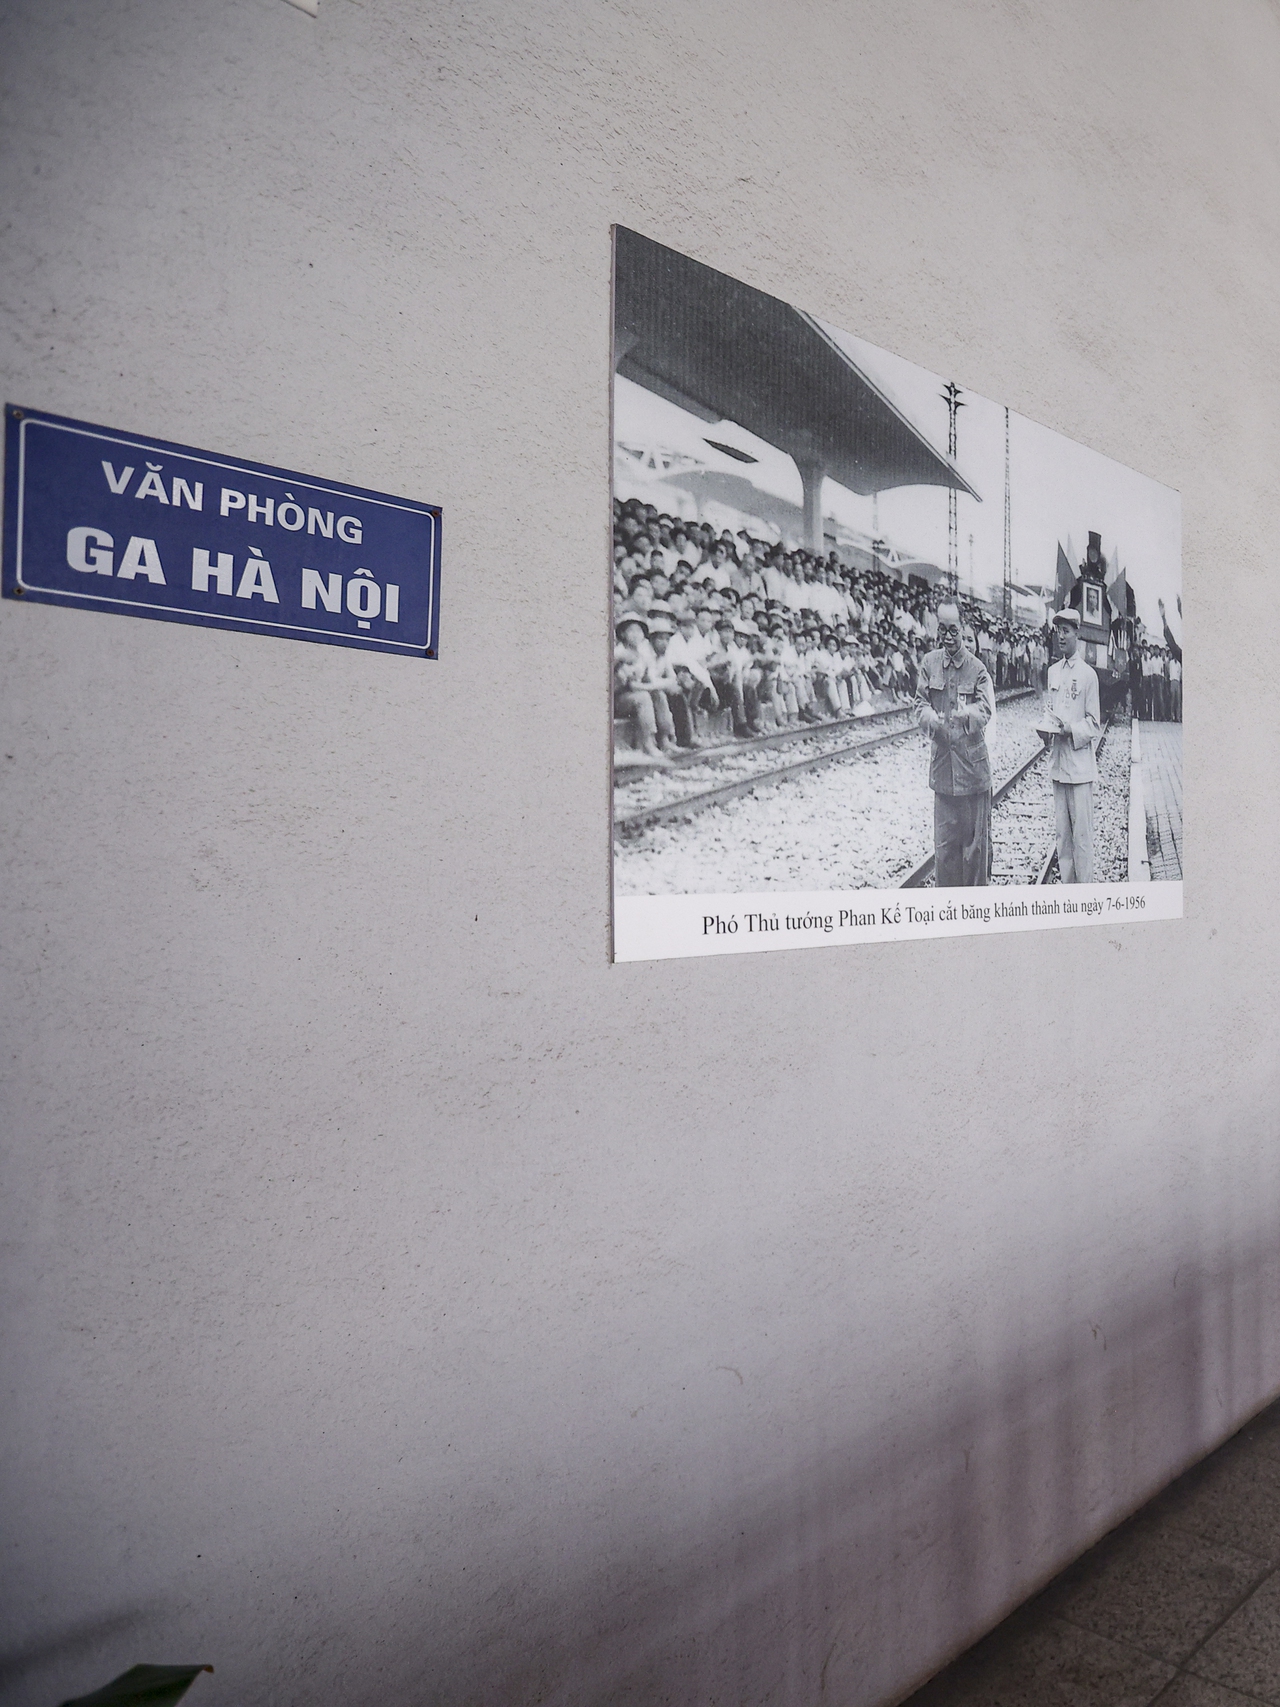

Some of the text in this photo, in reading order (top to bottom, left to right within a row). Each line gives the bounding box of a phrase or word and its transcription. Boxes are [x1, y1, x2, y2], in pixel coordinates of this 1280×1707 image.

[101, 461, 364, 545] VĂN PHÒNG
[66, 526, 400, 630] GA HÀ NỘI
[702, 895, 1146, 936] Phó Thủ tướng Phan Kế Toại cắt băng khánh thành tàu ngày 7-6-1956
